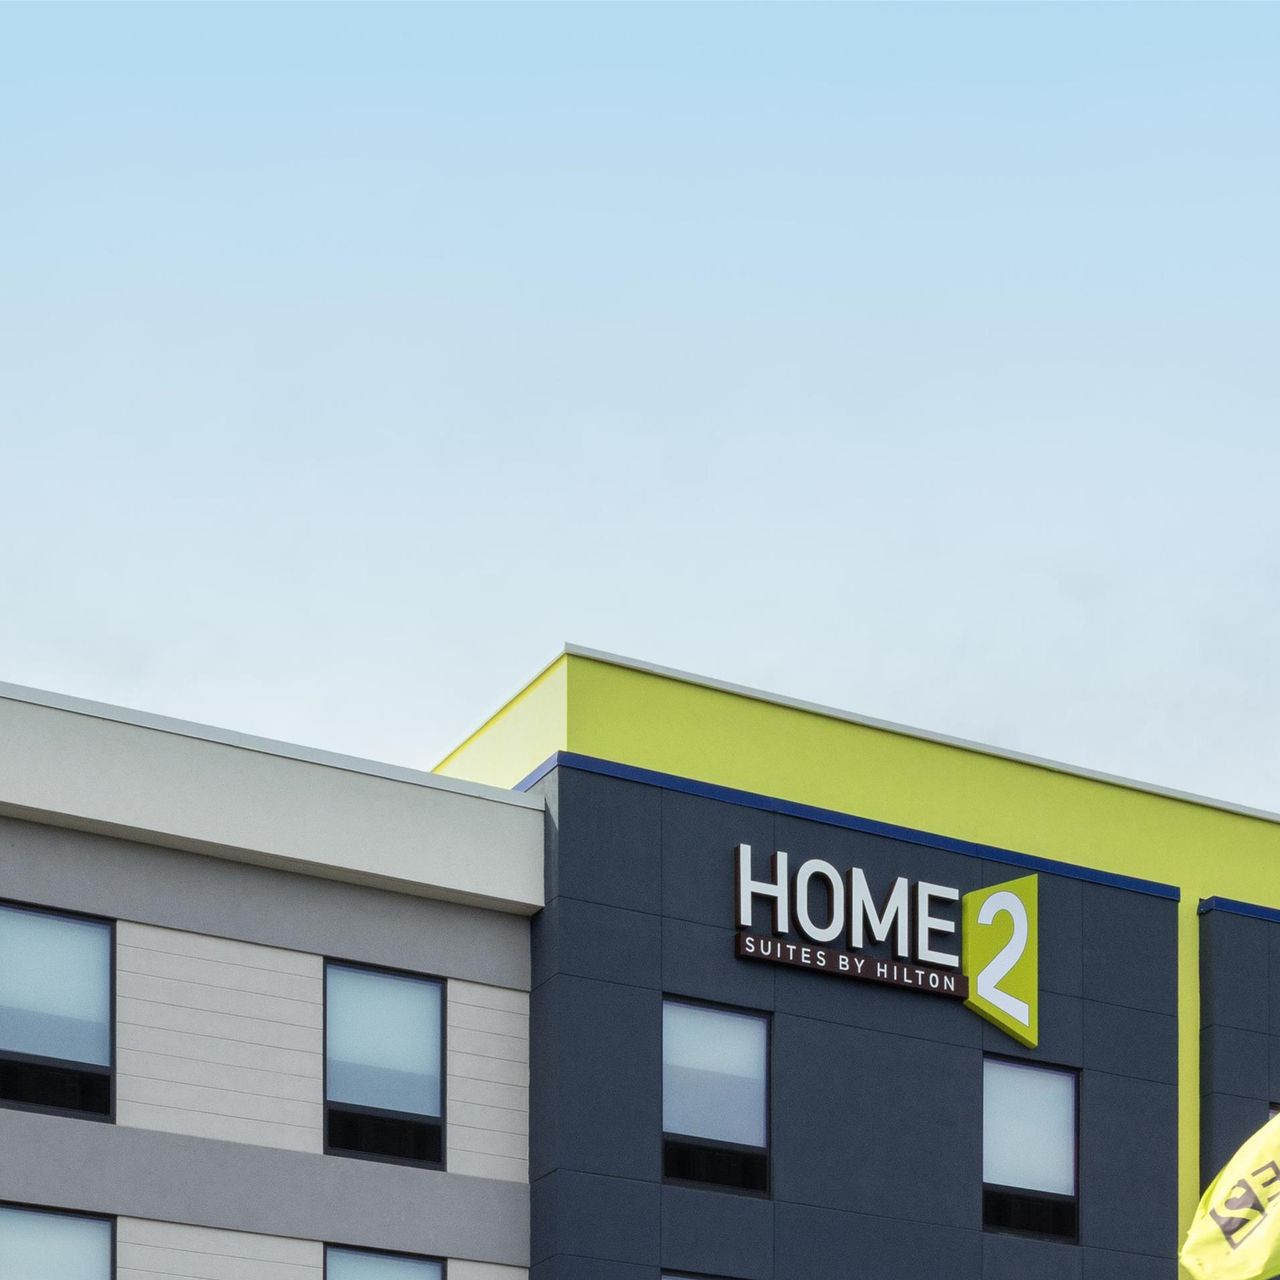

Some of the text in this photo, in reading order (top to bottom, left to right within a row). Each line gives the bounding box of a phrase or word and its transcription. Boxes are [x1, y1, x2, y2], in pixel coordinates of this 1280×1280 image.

[745, 937, 955, 992] SUITES BY HILTON
